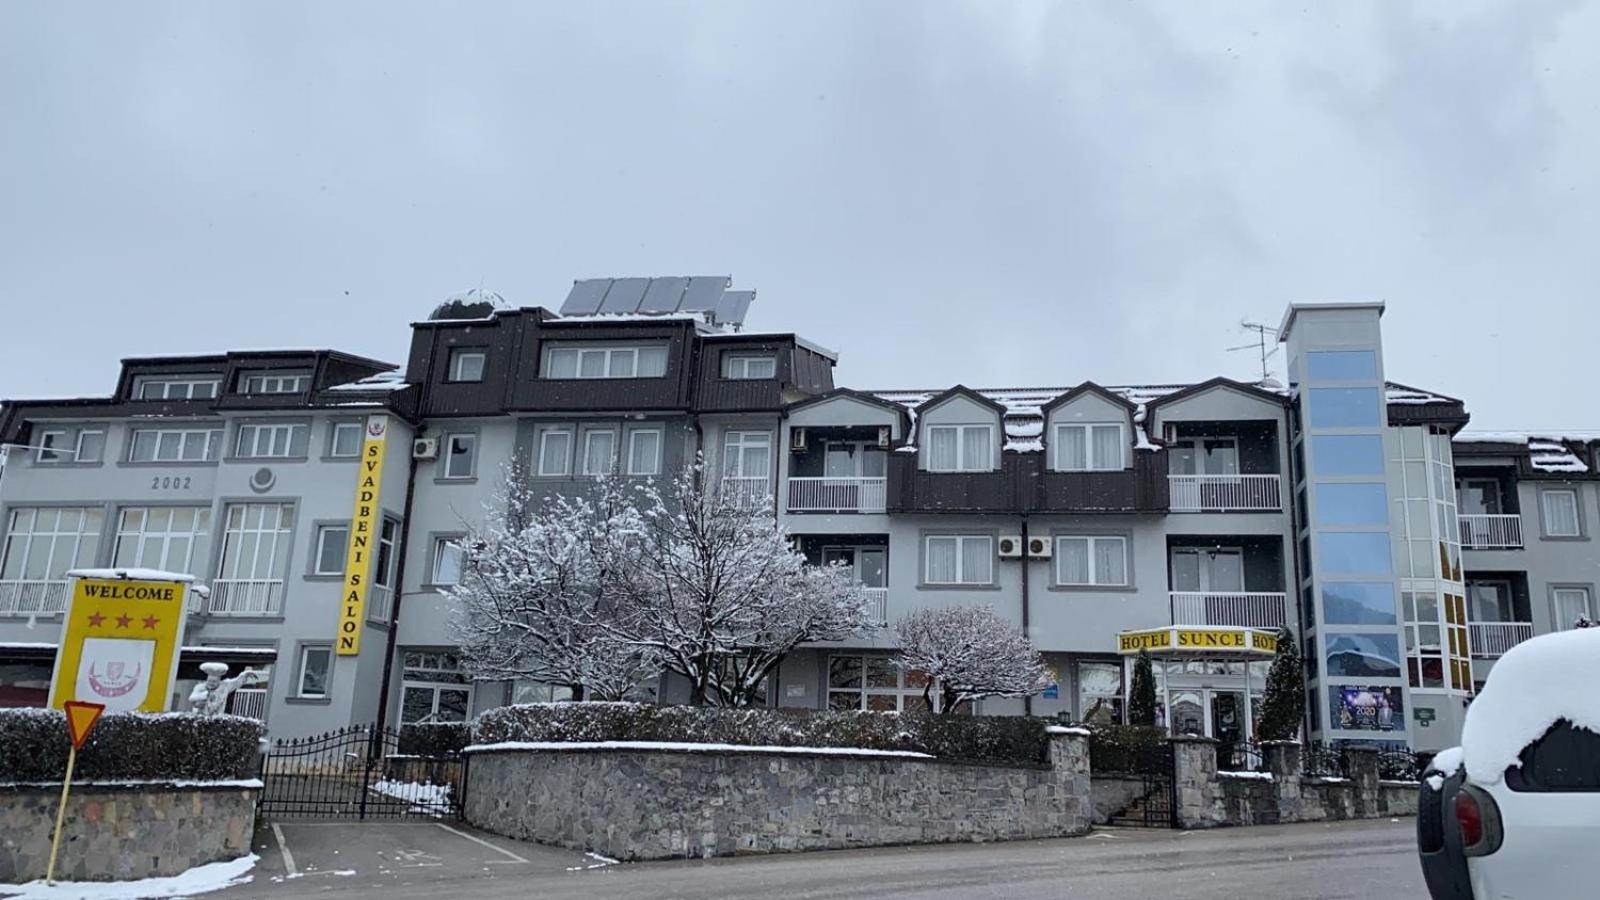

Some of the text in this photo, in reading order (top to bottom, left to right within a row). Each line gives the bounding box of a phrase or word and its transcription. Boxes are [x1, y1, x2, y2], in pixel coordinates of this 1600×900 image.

[151, 476, 191, 490] 2002
[340, 445, 379, 649] SVADBENI SALON
[84, 584, 174, 601] WELCOME
[1121, 633, 1169, 650] HOTEL
[1178, 633, 1245, 646] SUNCE
[1355, 706, 1376, 717] 2020
